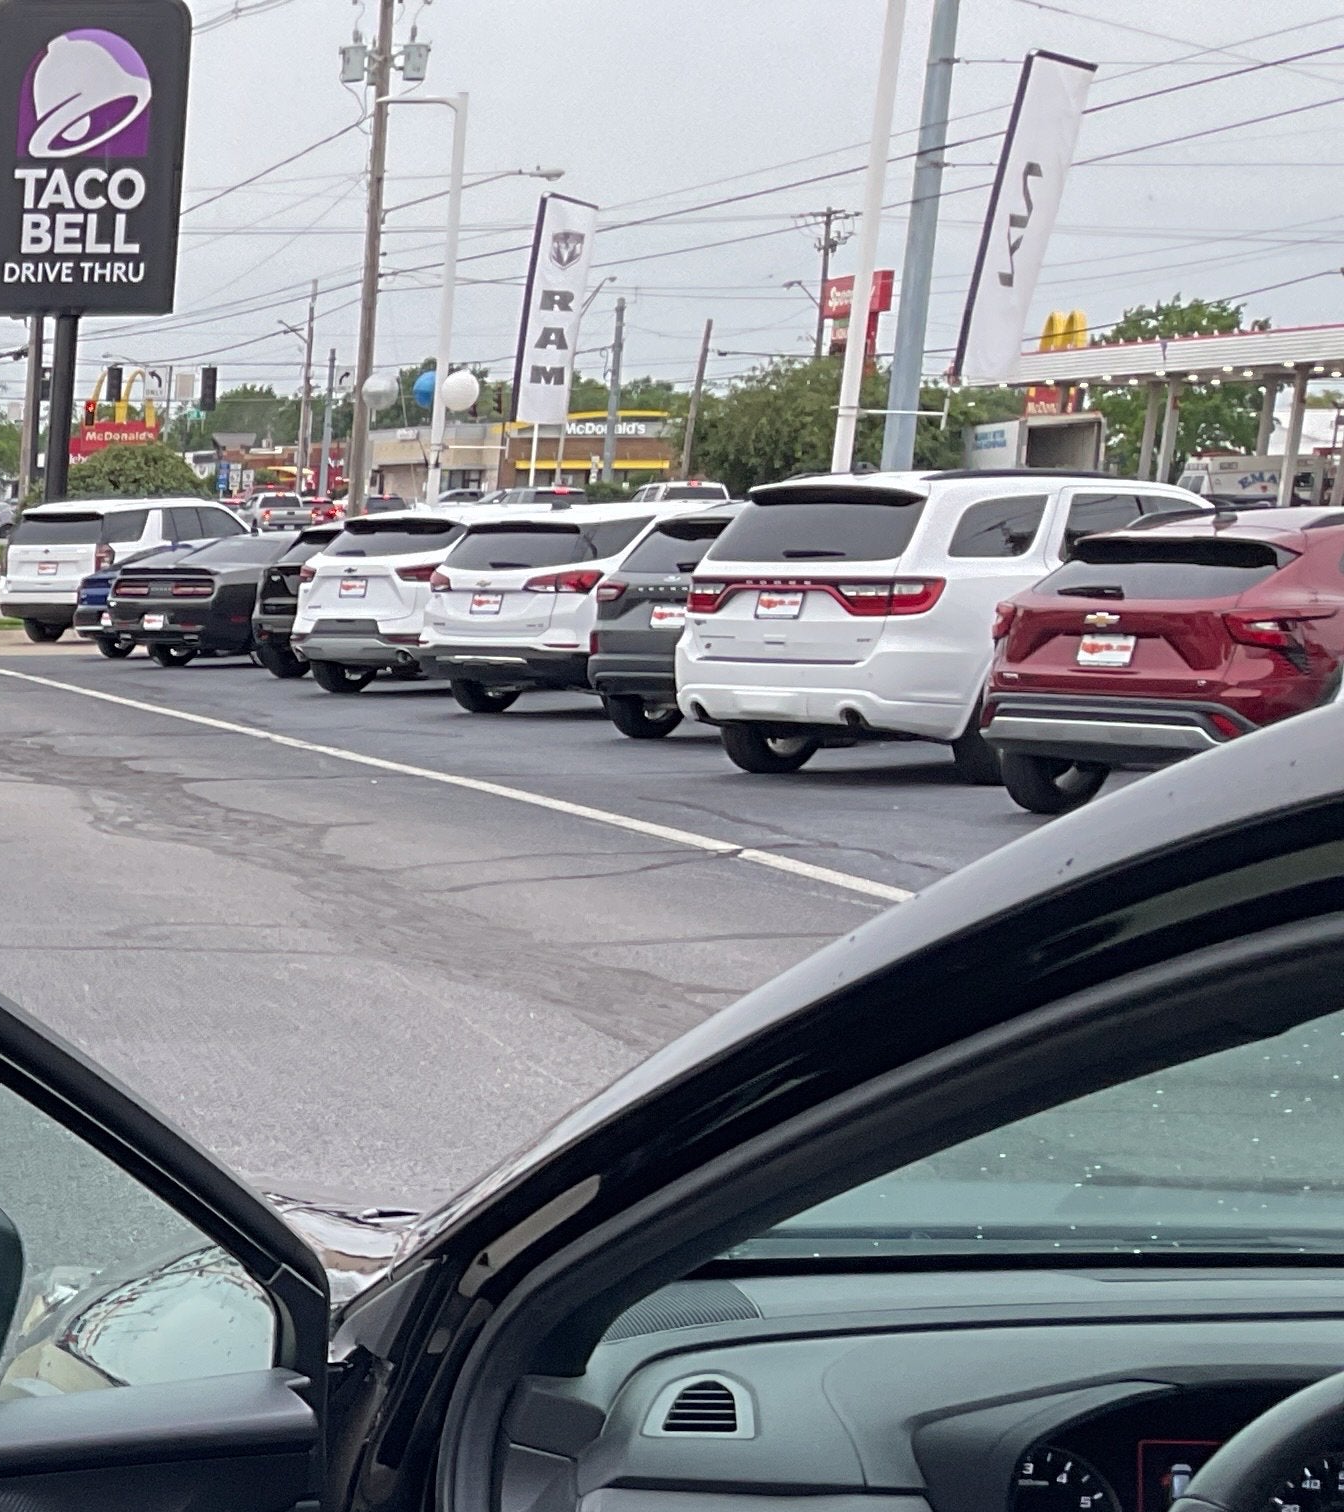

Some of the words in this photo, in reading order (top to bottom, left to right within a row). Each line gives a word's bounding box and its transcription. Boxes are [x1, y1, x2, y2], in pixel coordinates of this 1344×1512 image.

[14, 167, 146, 211] TACO
[21, 213, 140, 255] BELL
[3, 262, 75, 284] DRIVE
[79, 262, 146, 284] THRU
[530, 288, 574, 387] RAM
[564, 421, 647, 436] McDoald's
[85, 430, 155, 442] McDonald's
[1022, 1462, 1034, 1475] 3
[1056, 1472, 1068, 1484] 4
[1301, 1479, 1321, 1490] 40
[1079, 1495, 1092, 1509] 5
